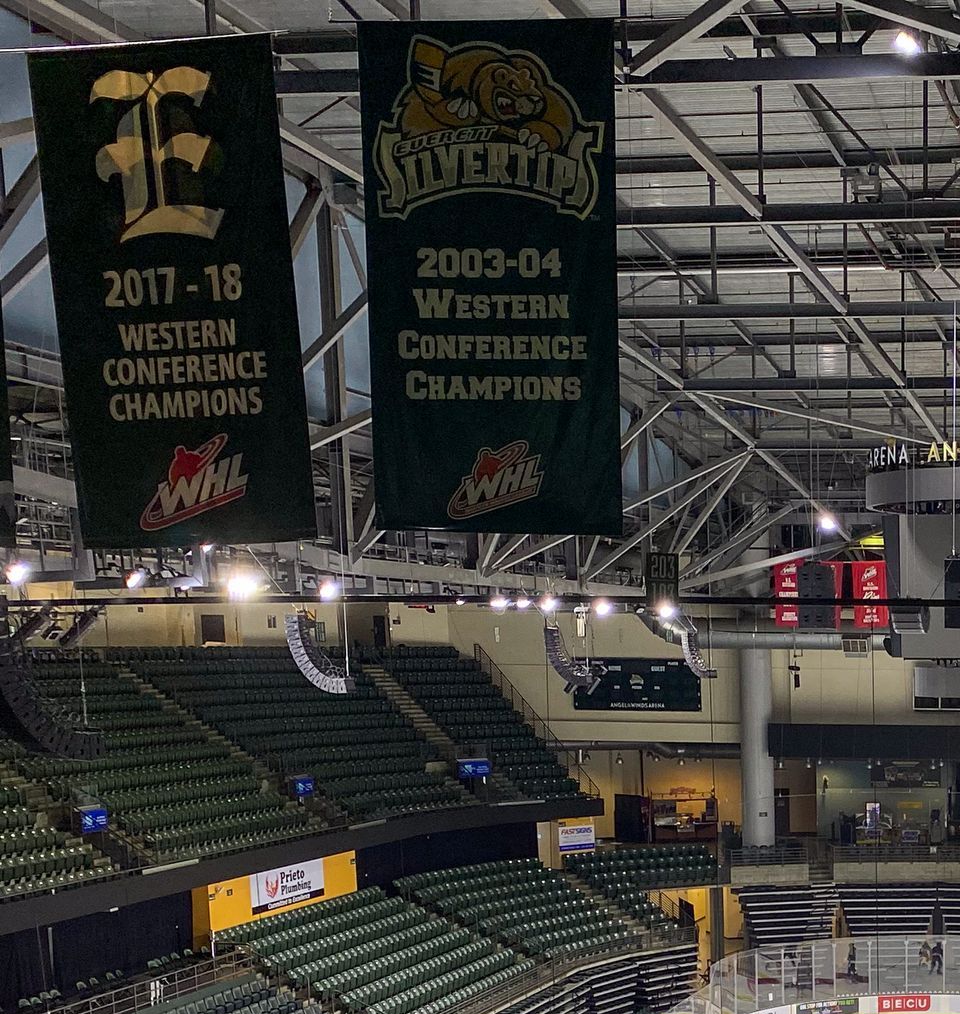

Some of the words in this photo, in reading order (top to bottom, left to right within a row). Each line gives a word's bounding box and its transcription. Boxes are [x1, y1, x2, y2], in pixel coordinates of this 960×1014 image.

[394, 125, 499, 156] EVERETT
[380, 131, 593, 207] SILVERTIPS
[417, 248, 561, 278] 2003-04
[104, 267, 175, 307] 2017
[211, 264, 242, 301] 18
[413, 289, 569, 319] WESTERN
[118, 318, 236, 351] WESTERN
[398, 333, 587, 360] CONFERENCE
[103, 350, 267, 386] CONFERENCE
[405, 375, 581, 400] CHAMPIONS
[109, 386, 263, 421] CHAMPIONS
[868, 444, 909, 467] ARENA
[161, 452, 249, 518] WHL
[465, 455, 543, 502] WHL
[651, 555, 675, 578] 203
[561, 826, 592, 836] FASTSIGNS
[280, 869, 305, 884] Prieto
[280, 880, 312, 896] Plumbing
